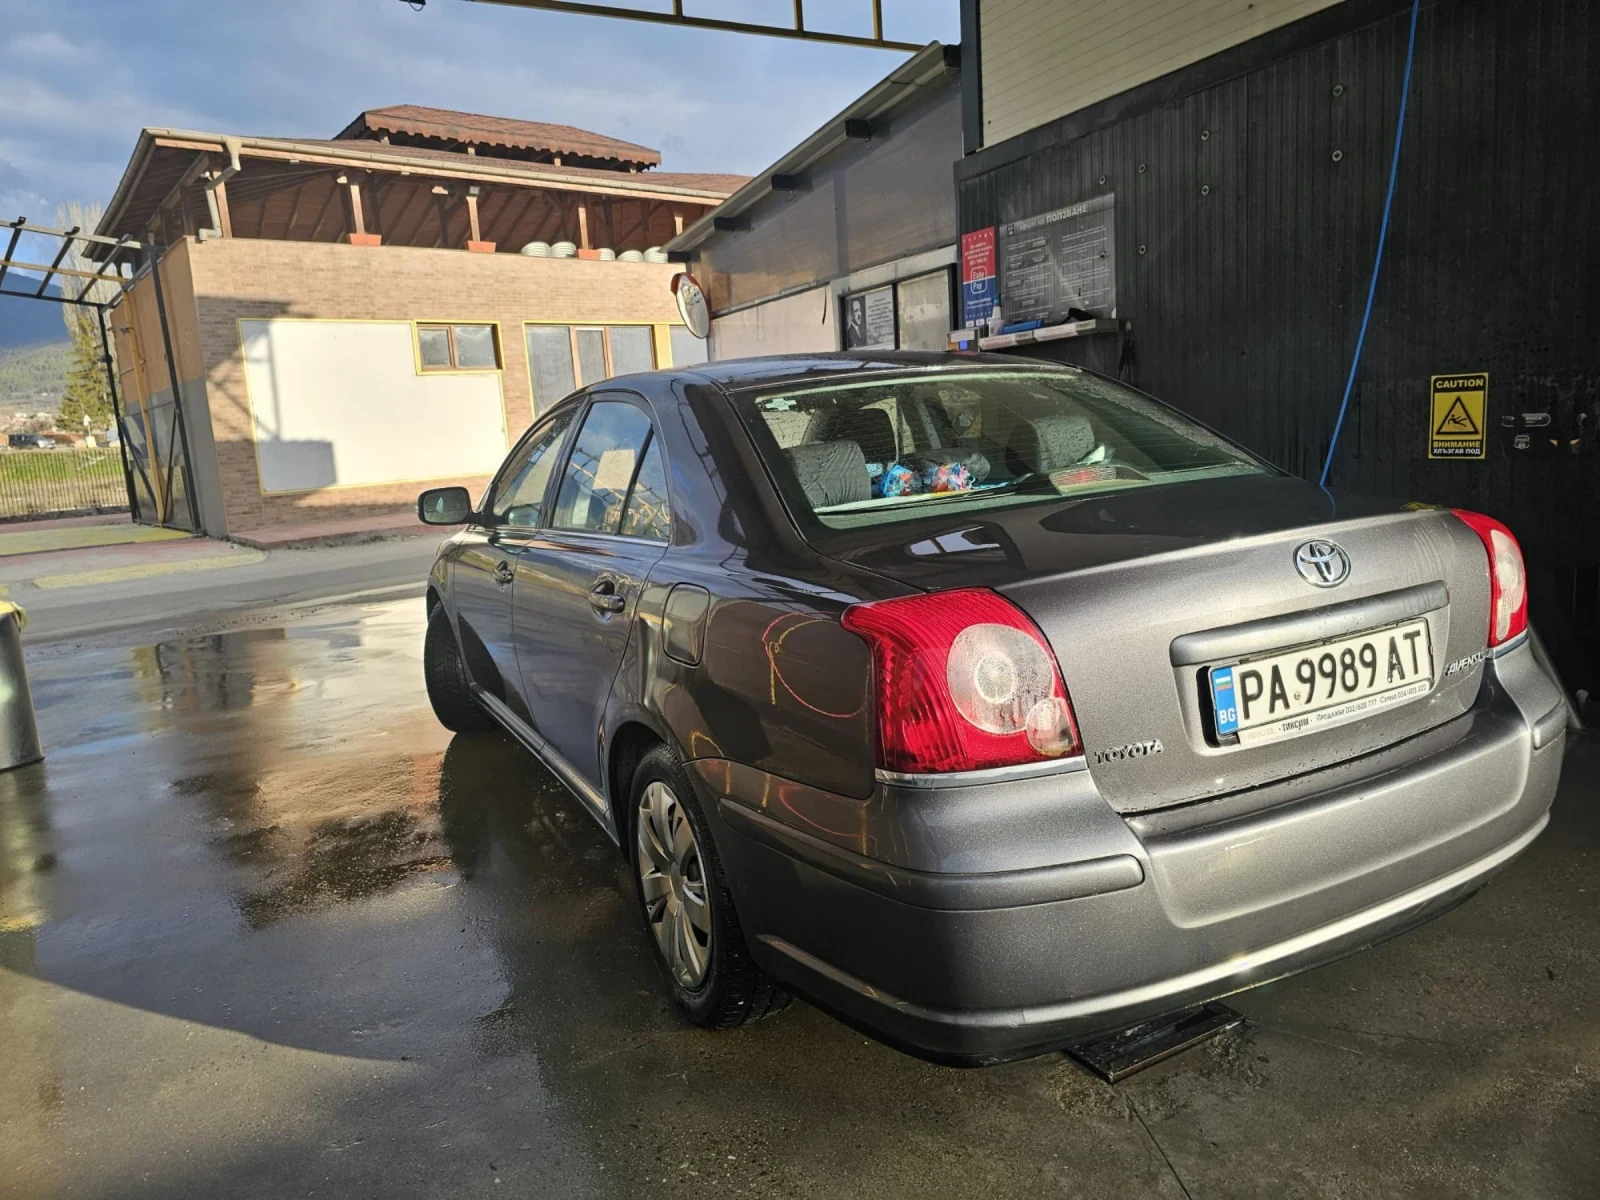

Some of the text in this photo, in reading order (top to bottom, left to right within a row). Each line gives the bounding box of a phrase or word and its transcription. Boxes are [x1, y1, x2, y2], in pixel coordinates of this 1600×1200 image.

[1046, 204, 1088, 223] ПОЛЗВАНЕ
[972, 271, 985, 280] Easy
[972, 282, 982, 290] Pay
[1436, 379, 1483, 388] CAUTION
[1239, 630, 1421, 720] PA 9989 AT
[1368, 698, 1377, 707] 777
[1219, 706, 1236, 725] BG
[1094, 738, 1164, 764] TOYOTA
